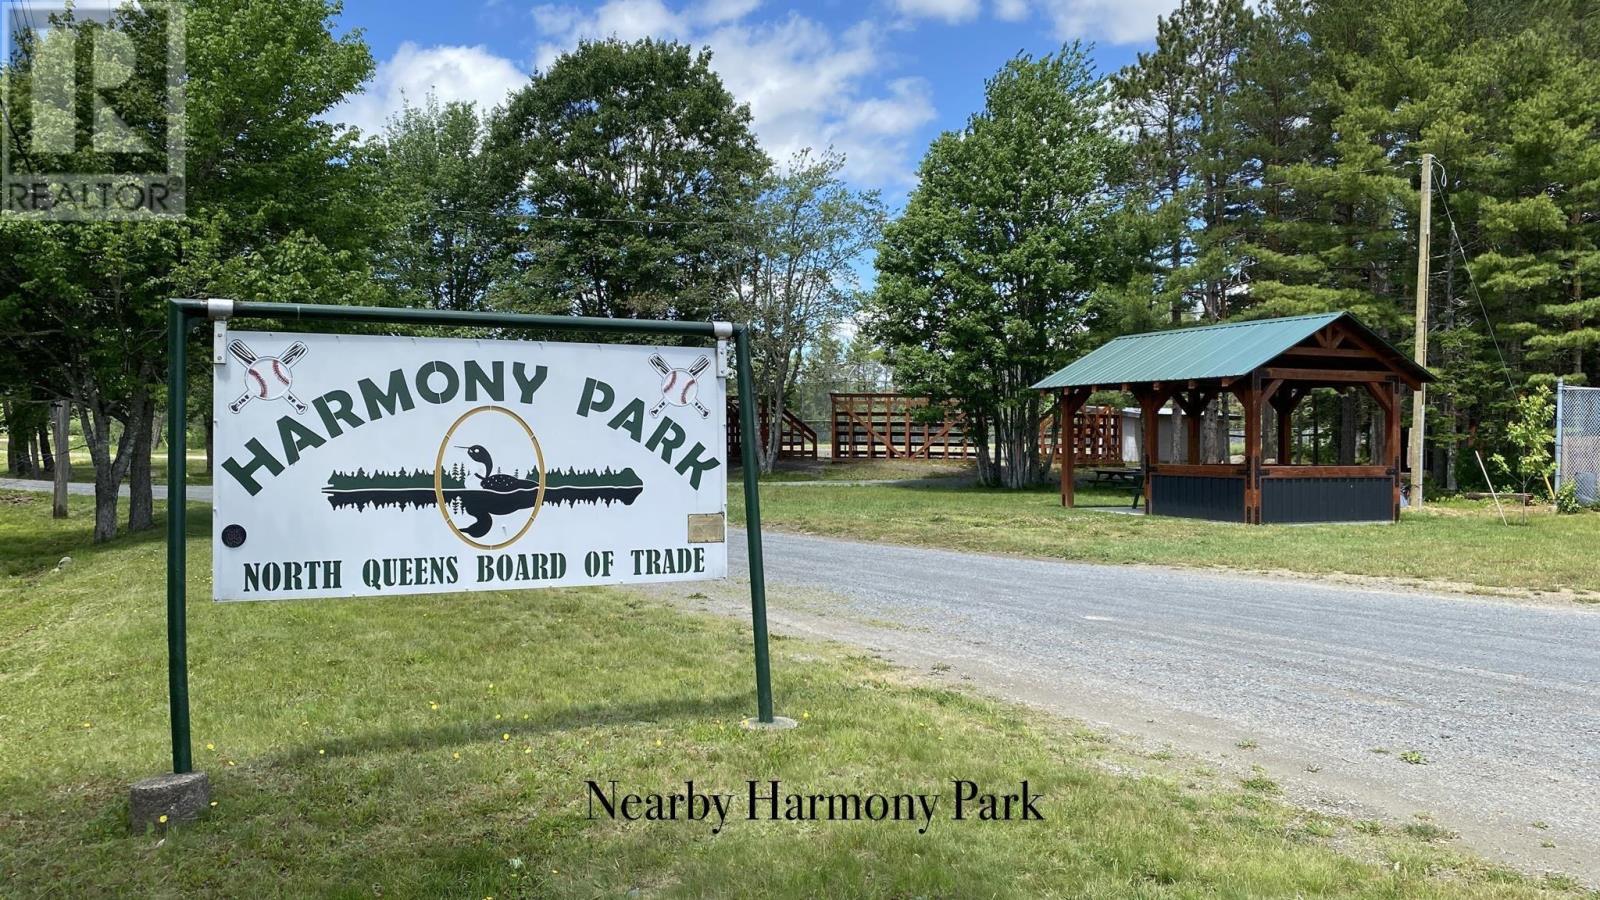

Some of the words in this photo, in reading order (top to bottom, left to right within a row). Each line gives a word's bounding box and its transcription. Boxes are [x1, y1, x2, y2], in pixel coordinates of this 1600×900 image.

[221, 360, 548, 496] HARMONY
[576, 377, 720, 491] PARK
[243, 560, 342, 592] NORTH
[362, 556, 459, 590] QUEENS
[476, 552, 567, 583] BOARD
[584, 551, 614, 577] OF
[631, 547, 705, 576] TRADE
